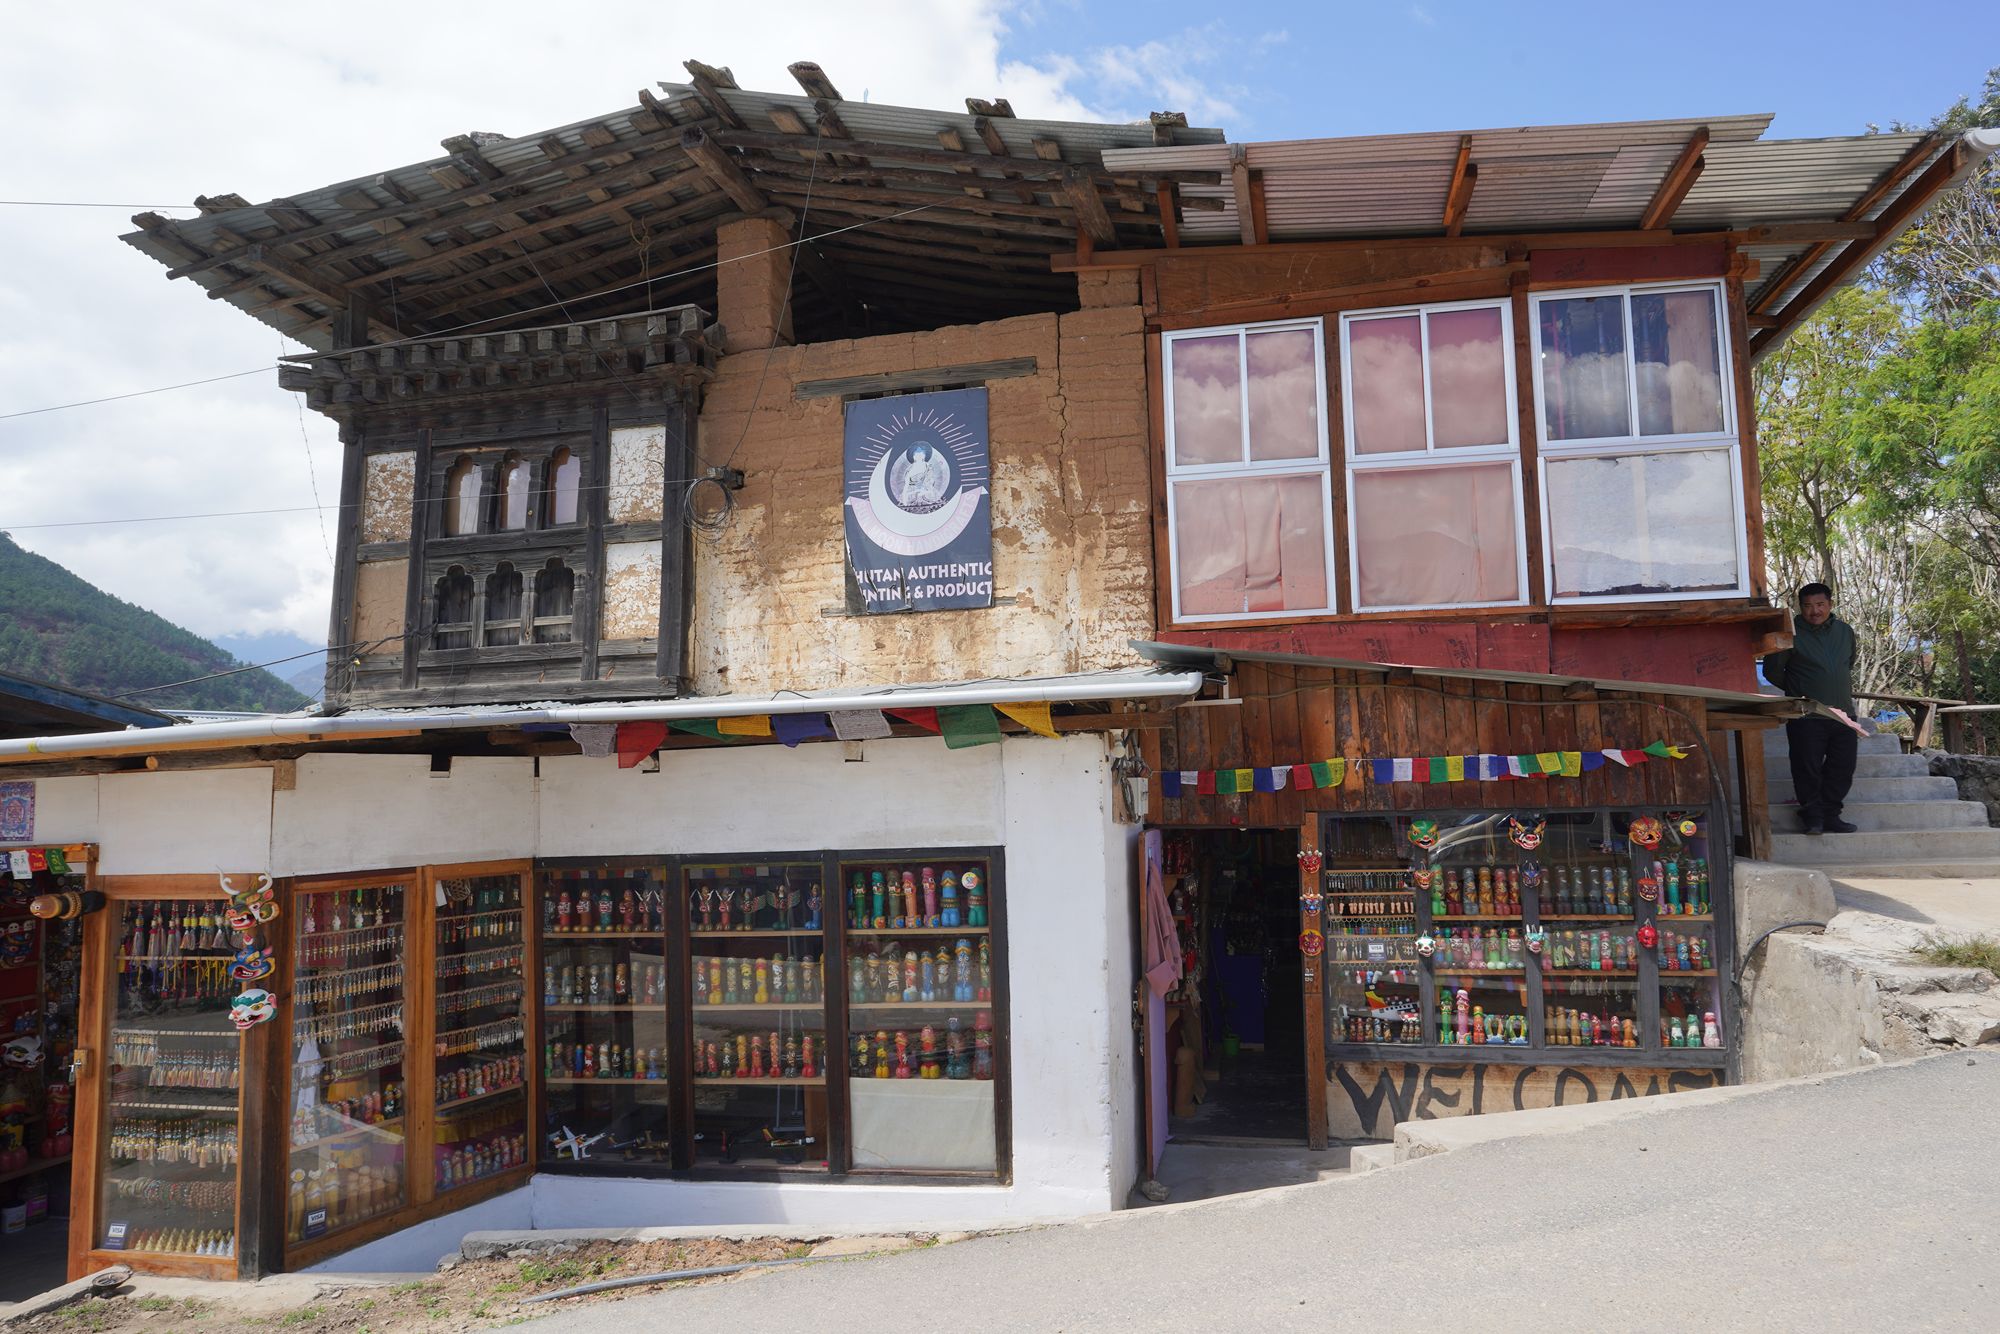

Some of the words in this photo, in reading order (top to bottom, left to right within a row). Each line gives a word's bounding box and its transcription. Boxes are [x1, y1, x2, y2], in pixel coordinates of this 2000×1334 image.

[854, 567, 904, 583] HUTAN
[908, 561, 992, 580] AUTHENTIC
[914, 586, 925, 599] &
